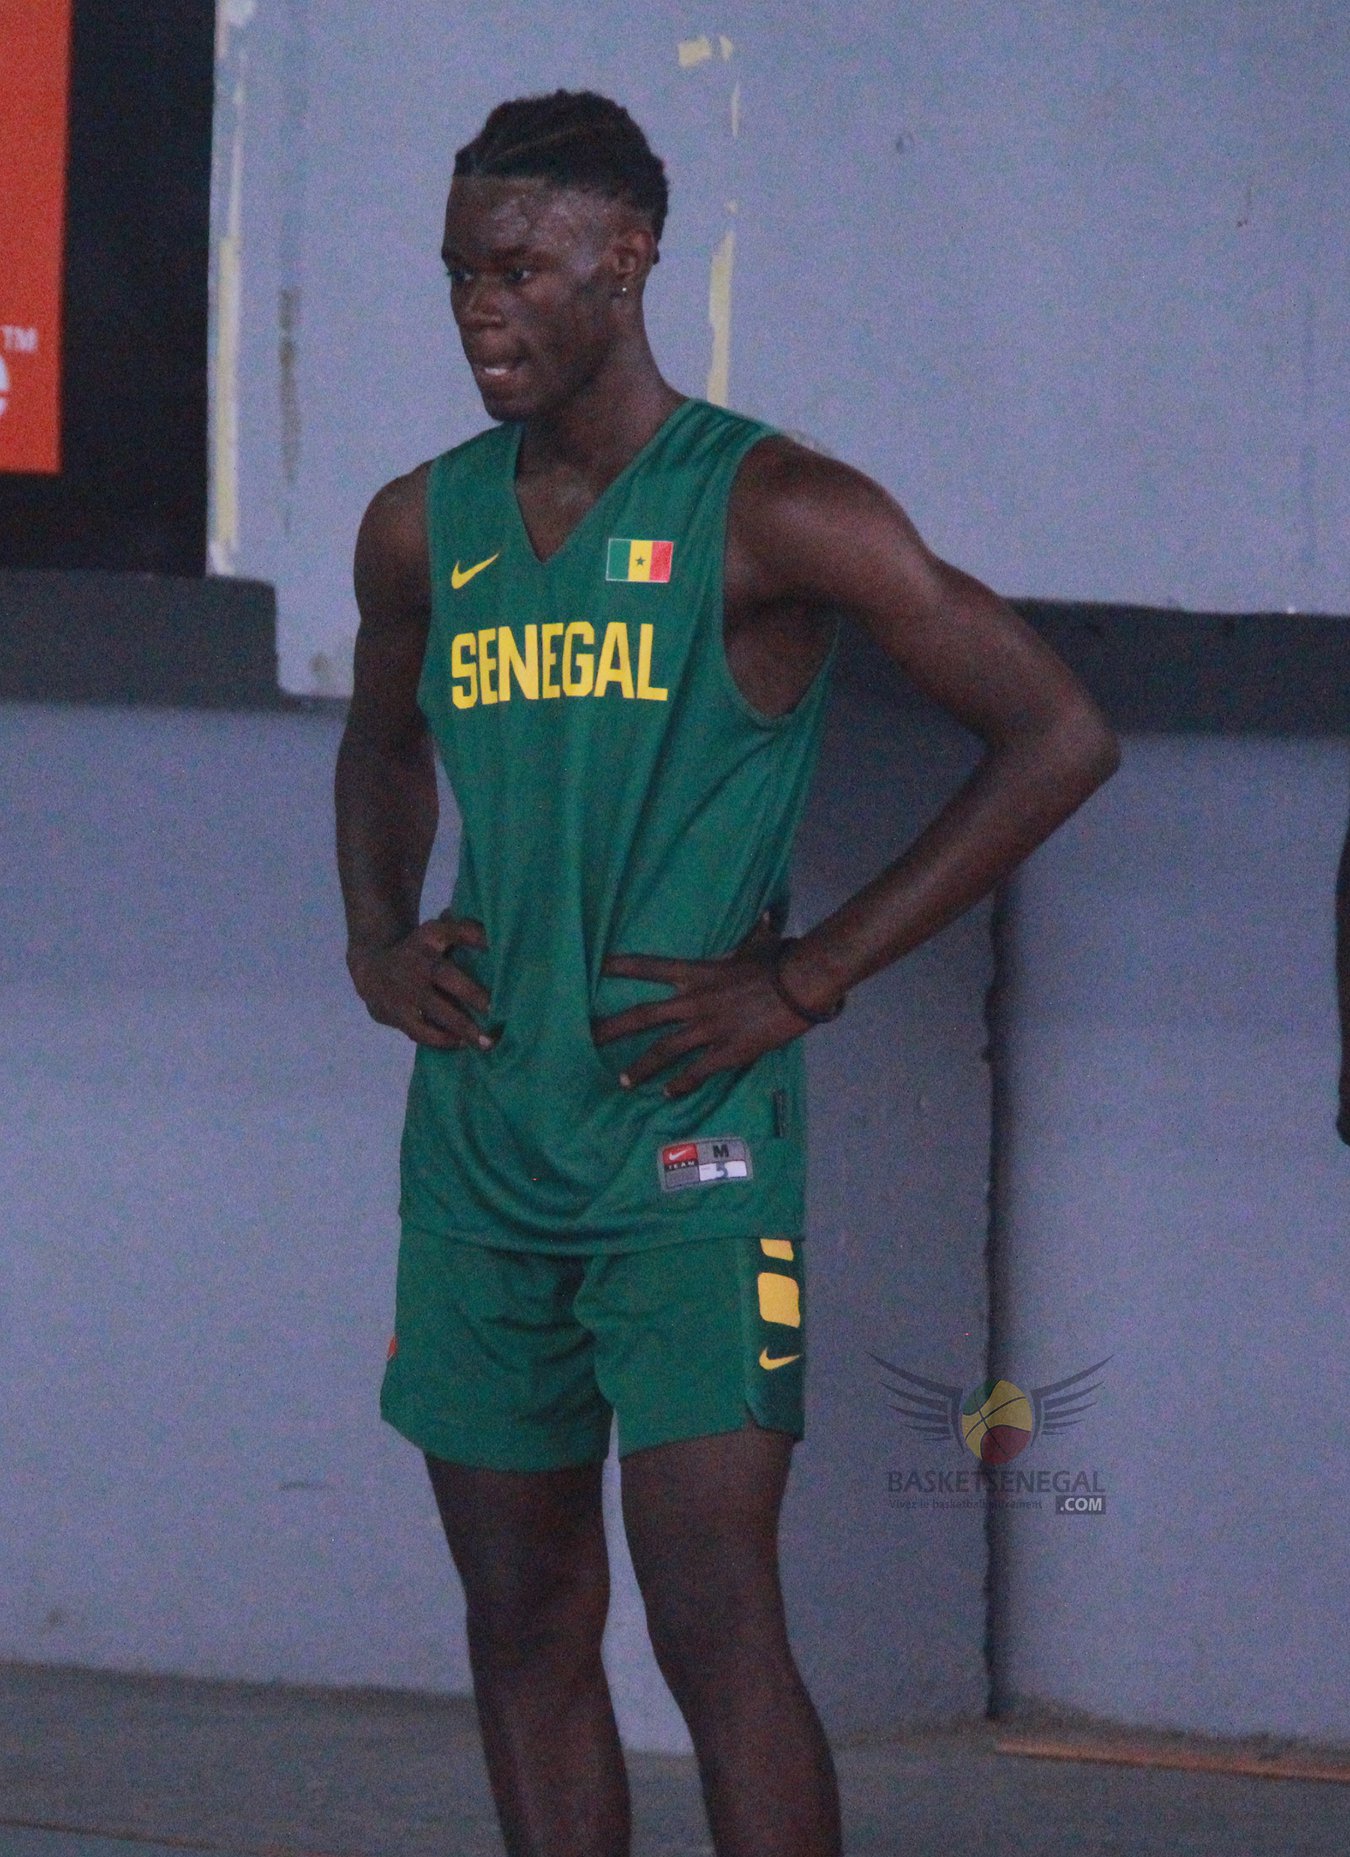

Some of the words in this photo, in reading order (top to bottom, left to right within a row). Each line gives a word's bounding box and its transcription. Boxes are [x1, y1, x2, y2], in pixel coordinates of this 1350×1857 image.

[451, 621, 668, 709] SENEGAL
[713, 1144, 729, 1158] M
[668, 1160, 695, 1170] TEAM
